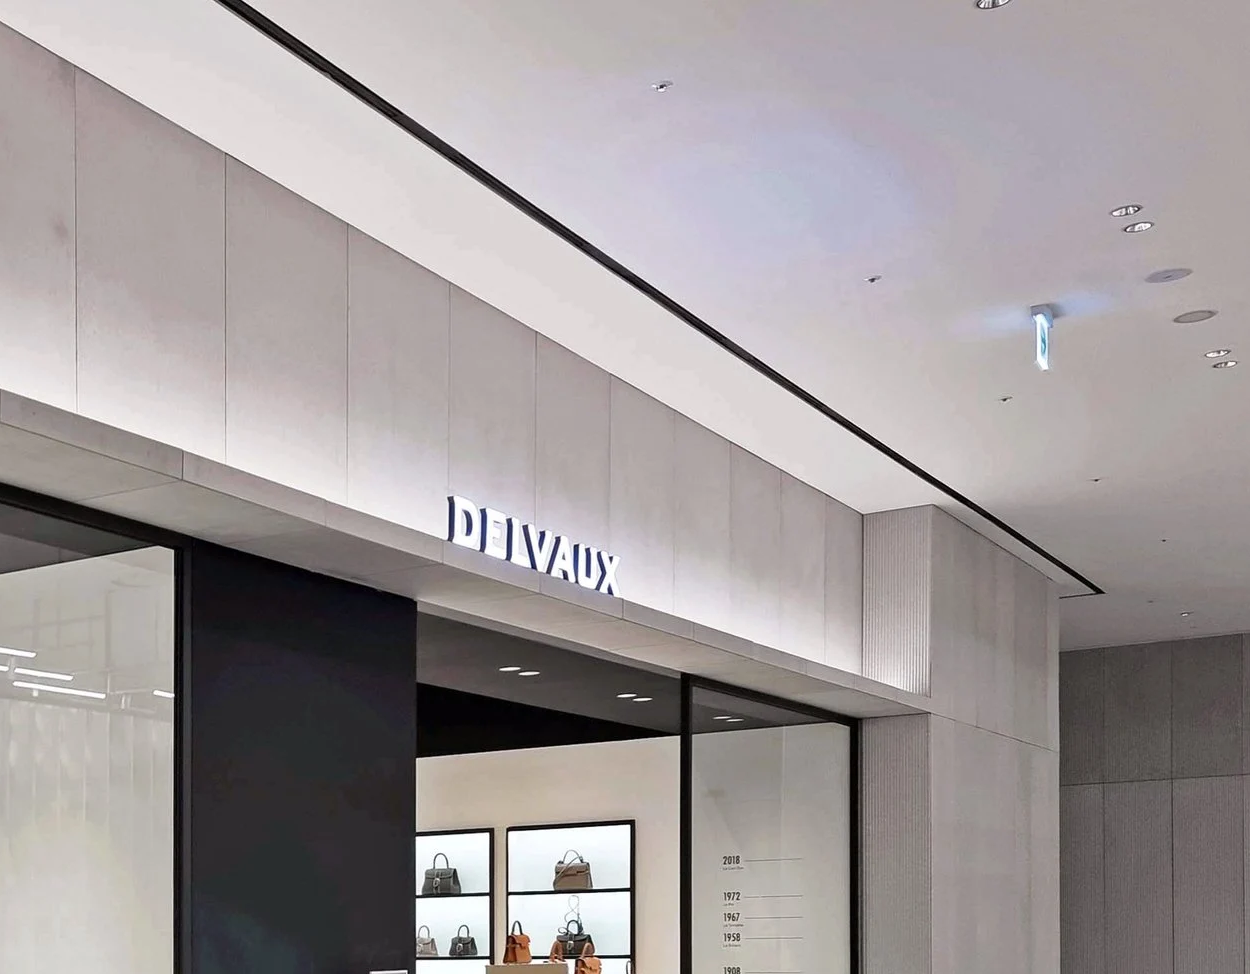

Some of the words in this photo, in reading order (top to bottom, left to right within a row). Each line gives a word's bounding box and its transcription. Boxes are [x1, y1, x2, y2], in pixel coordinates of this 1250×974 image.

[447, 496, 621, 598] DELVAUX
[723, 855, 740, 865] 2018
[723, 892, 740, 901] 1972
[723, 913, 740, 922] 1967
[723, 933, 740, 942] 1958
